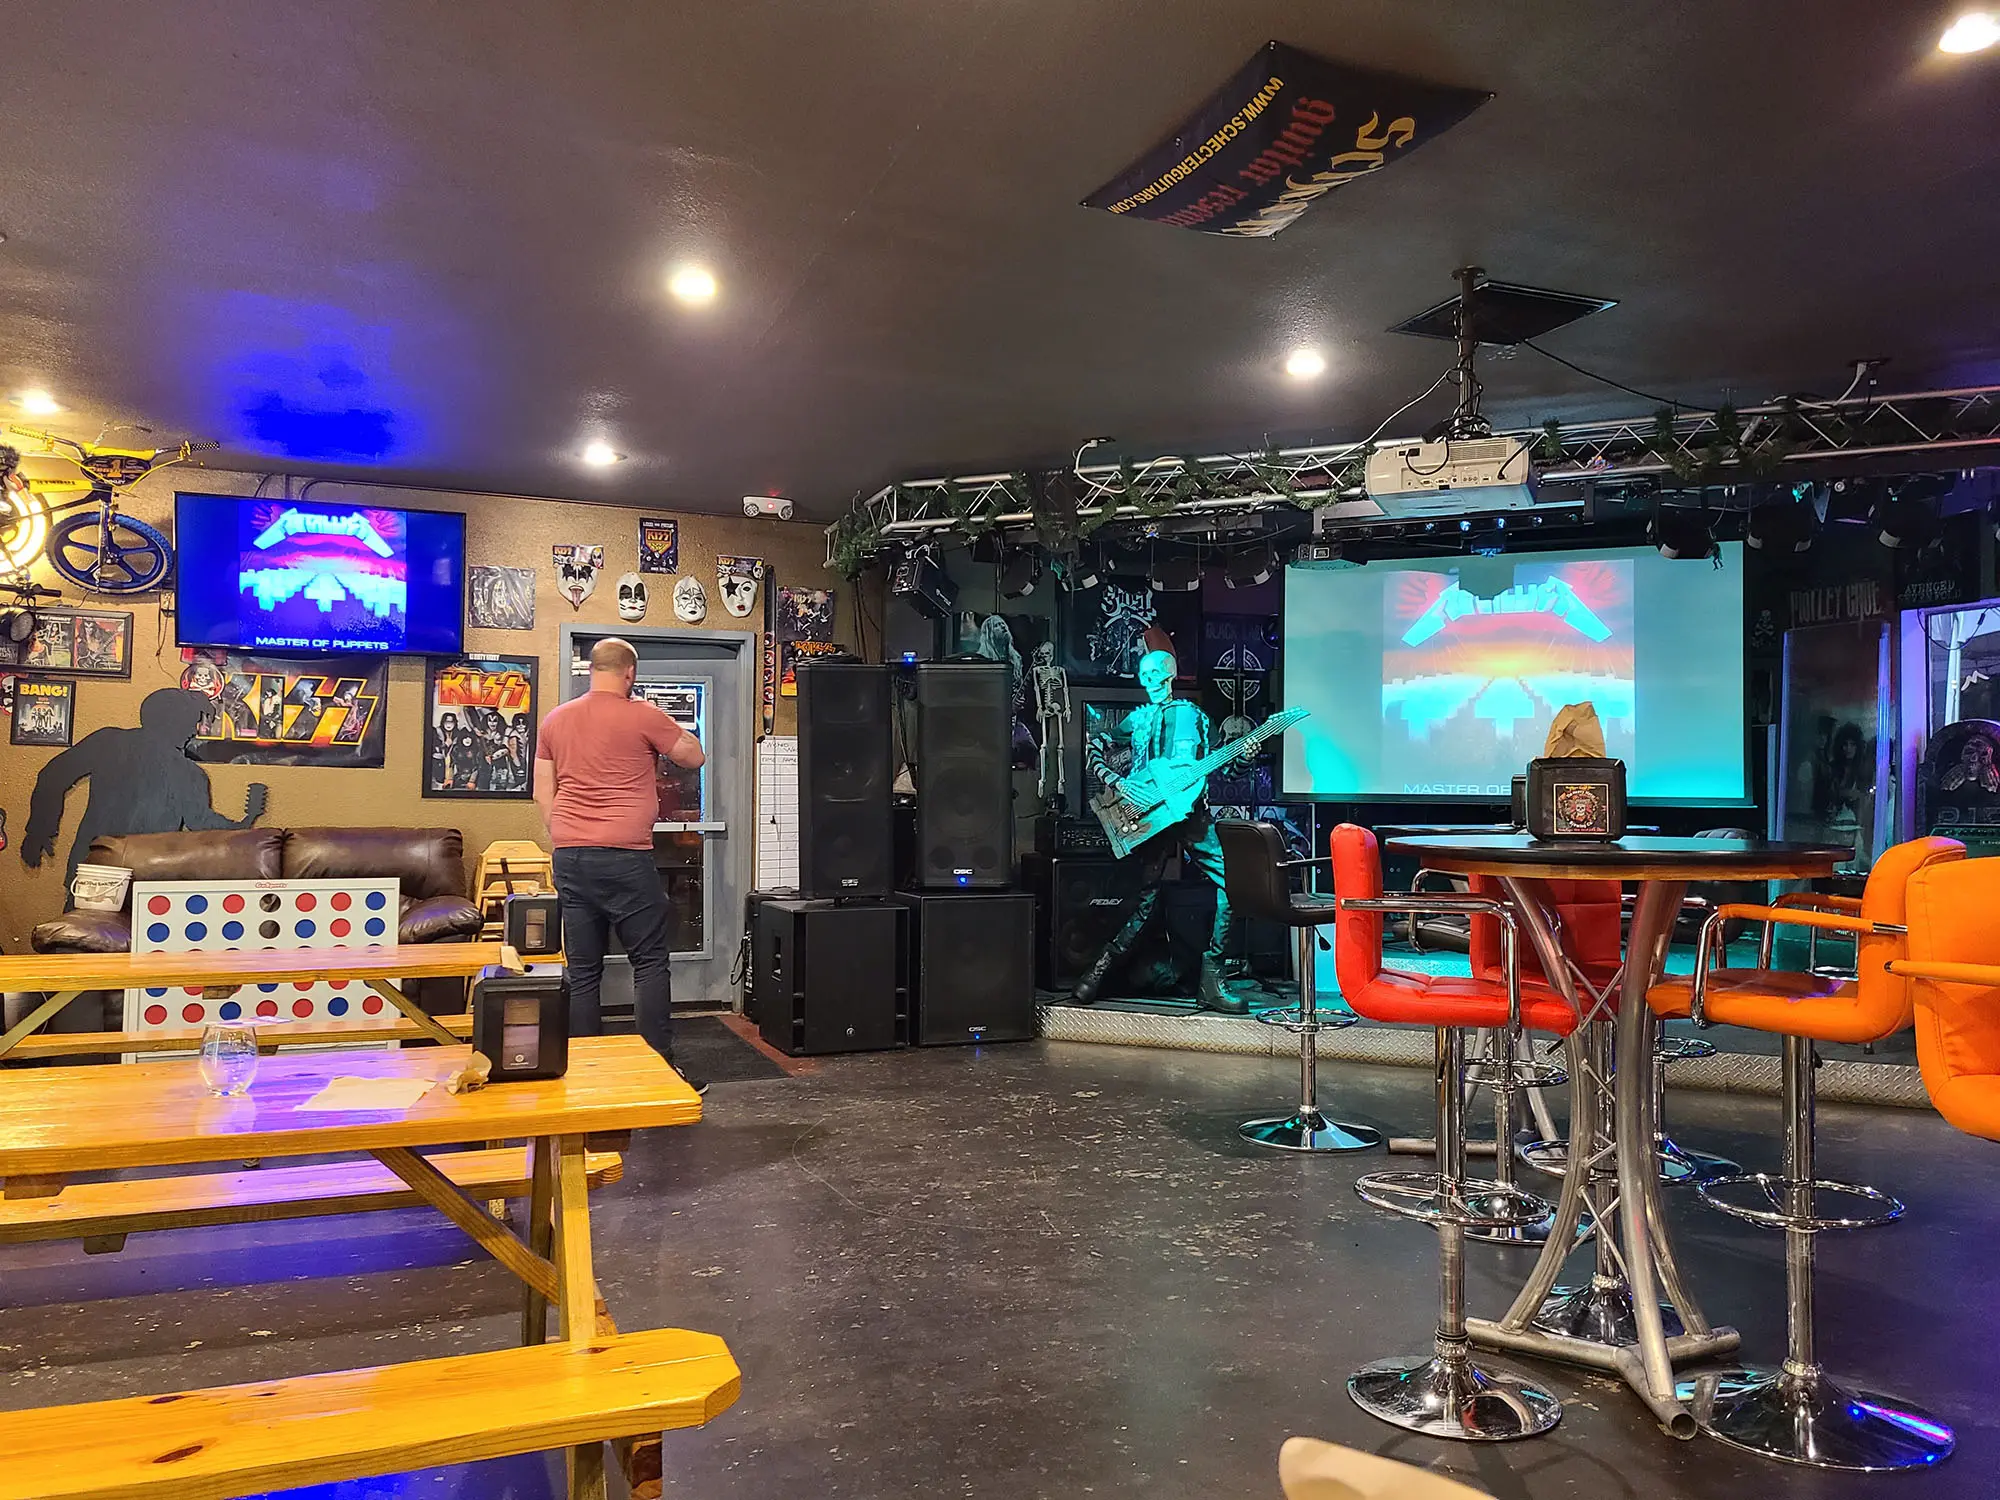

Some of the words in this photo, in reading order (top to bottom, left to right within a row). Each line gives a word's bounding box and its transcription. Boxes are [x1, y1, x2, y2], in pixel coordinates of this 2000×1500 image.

[1107, 76, 1285, 214] WWW.SCHECTERGUITARS.COM
[255, 636, 310, 647] MASTER
[312, 639, 330, 648] OF
[333, 640, 389, 650] PUPPETS
[20, 683, 68, 697] BANG!
[438, 669, 529, 708] KISS
[196, 672, 380, 745] KISS
[1404, 783, 1481, 795] MASTER
